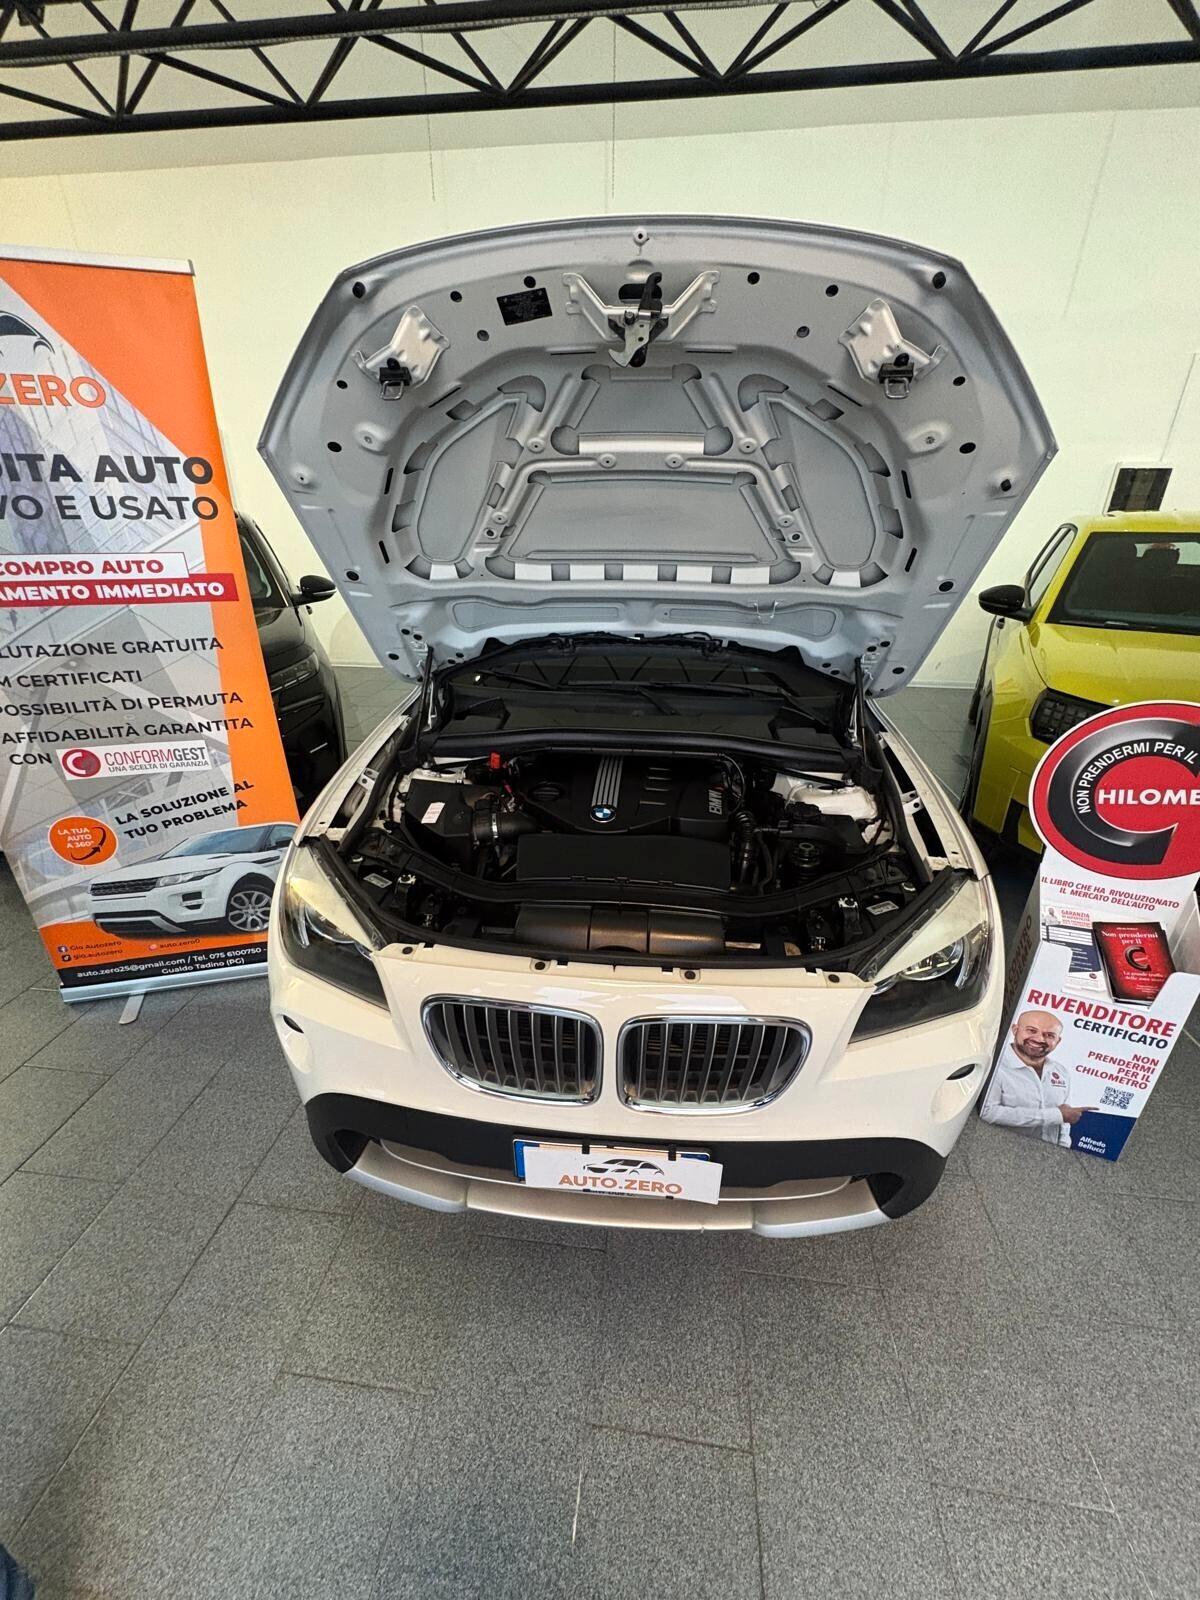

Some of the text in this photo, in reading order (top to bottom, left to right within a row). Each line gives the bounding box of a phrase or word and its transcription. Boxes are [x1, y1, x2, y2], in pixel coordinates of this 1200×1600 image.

[0, 453, 213, 484] ITA AUTO
[55, 495, 81, 520] E
[90, 496, 218, 520] USATO
[101, 559, 164, 575] AUTO
[95, 582, 224, 600] IMMEDIATO
[122, 637, 224, 654] GRATUITA
[17, 670, 142, 688] CERTIFICATI
[0, 691, 243, 717] OSSIBILITÀ DI PERMUTA
[2, 717, 254, 744] AFFIDABILITÀ GARANTITA
[9, 747, 206, 766] CON CONFORMGEST
[129, 763, 158, 771] SCELTA
[169, 760, 210, 769] GARANZIA
[1076, 741, 1199, 814] NON PRENDERMI PER IL
[115, 780, 255, 825] LA SOLUZIONE AL
[708, 789, 722, 815] BMW
[123, 799, 248, 839] TUO PROBLEMA
[67, 834, 92, 842] AUTO
[70, 827, 90, 835] TUA
[1050, 878, 1074, 888] LIBRO
[1075, 883, 1092, 892] CHE
[1093, 886, 1106, 895] HA
[1109, 889, 1180, 909] RIVOLUZIONATO
[1059, 887, 1156, 912] IL MERCATO DELL'AUTO
[1118, 931, 1158, 940] prendermi
[77, 957, 186, 977] auto.zero25@gmail.com
[192, 954, 208, 962] Tel.
[209, 951, 225, 960] 075
[226, 947, 262, 957] 6100750
[161, 965, 194, 975] Gualdo
[194, 960, 225, 969] Tadino
[1027, 989, 1177, 1037] RIVENDITORE
[1073, 1018, 1169, 1049] CERTIFICATO
[1088, 1051, 1156, 1074] PRENDERMI
[1132, 1053, 1160, 1067] NON
[1075, 1064, 1148, 1090] CHILOMETRO
[1117, 1067, 1151, 1083] PER IL
[1078, 1141, 1106, 1154] Bellucci
[1080, 1136, 1106, 1148] Alfredo
[559, 1174, 683, 1194] AUTO.ZERO
